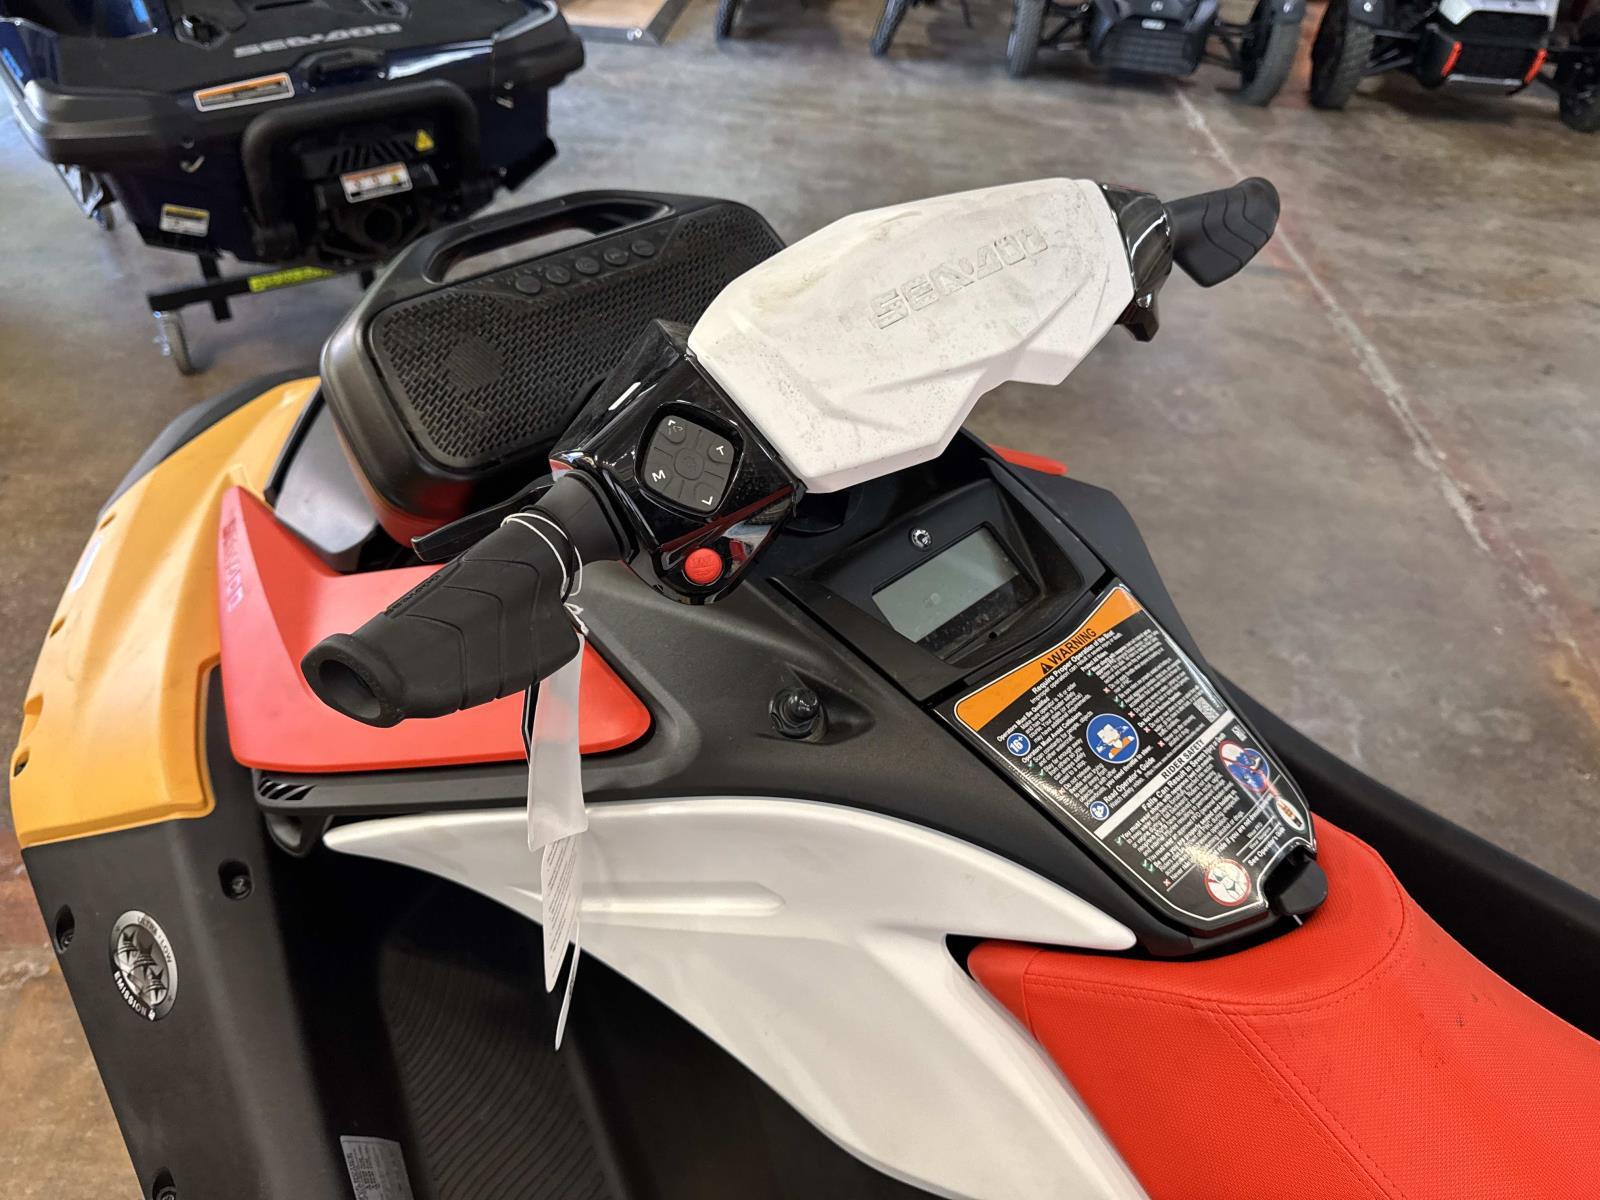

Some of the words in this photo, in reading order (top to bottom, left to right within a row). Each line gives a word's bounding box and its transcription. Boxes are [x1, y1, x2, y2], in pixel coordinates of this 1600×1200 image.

[651, 469, 667, 482] M
[1031, 675, 1056, 694] Require
[1052, 660, 1074, 677] Proper
[1070, 643, 1095, 662] Operation
[1047, 627, 1096, 665] WARNING
[996, 724, 1019, 742] Operators
[1030, 696, 1051, 712] Qualified
[1021, 745, 1044, 763] Operators
[1049, 726, 1064, 738] Avoid
[1061, 711, 1082, 728] Collisions
[1010, 736, 1024, 752] 16+
[1160, 757, 1185, 779] RIDER
[1182, 739, 1204, 759] SAFETY
[1102, 789, 1118, 803] Read
[1114, 768, 1144, 794] Operator's
[1138, 755, 1156, 771] Guide
[1141, 795, 1158, 811] Falls
[1155, 785, 1170, 798] Can
[1166, 769, 1187, 787] Result
[1189, 752, 1206, 767] Severe
[1256, 834, 1278, 858] Operator's
[114, 970, 148, 1017] EMISSION
